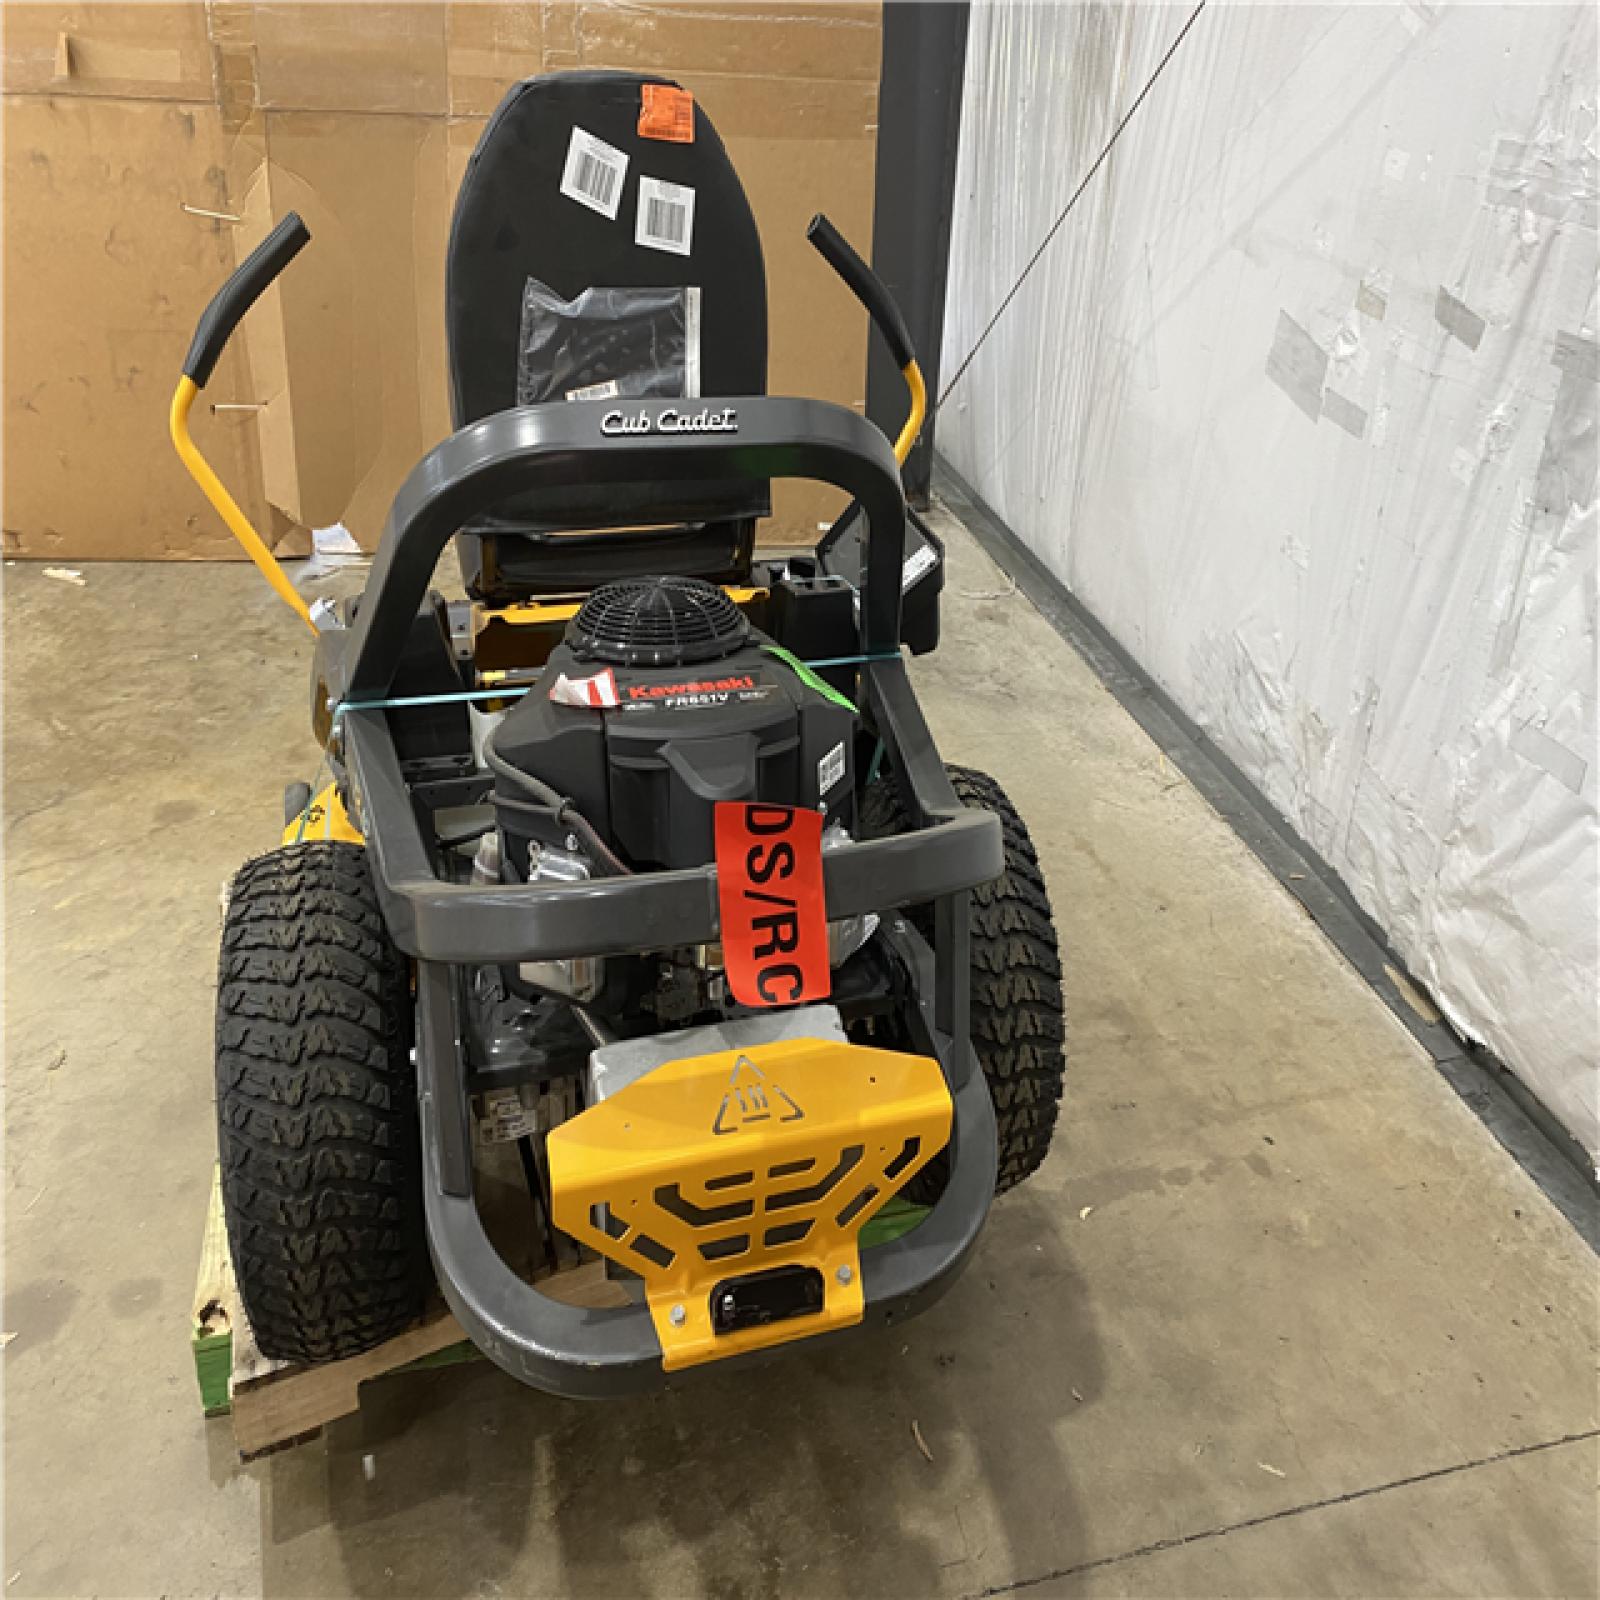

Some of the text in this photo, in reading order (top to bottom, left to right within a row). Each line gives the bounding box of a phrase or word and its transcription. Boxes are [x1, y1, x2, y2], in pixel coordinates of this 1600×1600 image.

[602, 407, 738, 432] Cub Cadet
[629, 675, 753, 699] Kawasaki
[744, 804, 803, 1003] DS/RC
